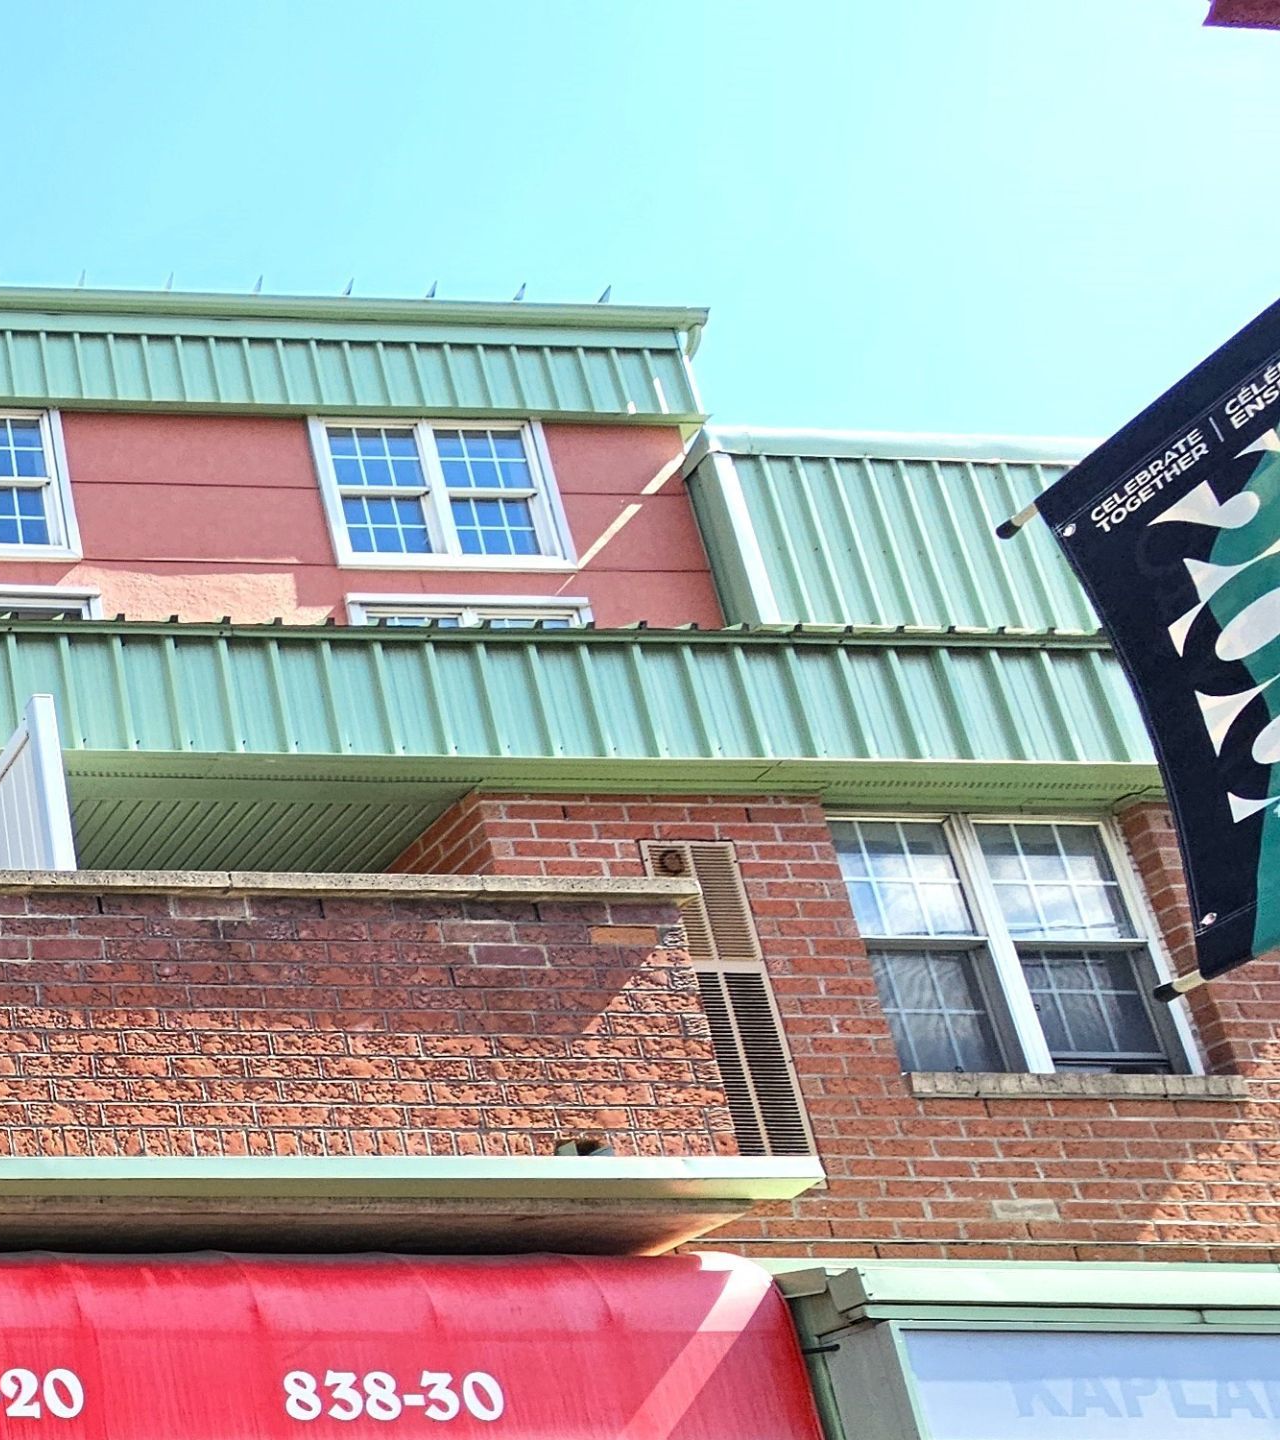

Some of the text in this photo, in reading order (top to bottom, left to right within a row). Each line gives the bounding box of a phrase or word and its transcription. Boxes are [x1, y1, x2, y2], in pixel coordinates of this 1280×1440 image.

[1225, 362, 1280, 415] CÉLÉ
[1230, 379, 1280, 429] ENS
[1091, 428, 1204, 521] CELEBRATE
[1096, 443, 1209, 532] TOGETHER
[283, 1371, 504, 1421] 838-30
[1008, 1377, 1280, 1419] KAPLA
